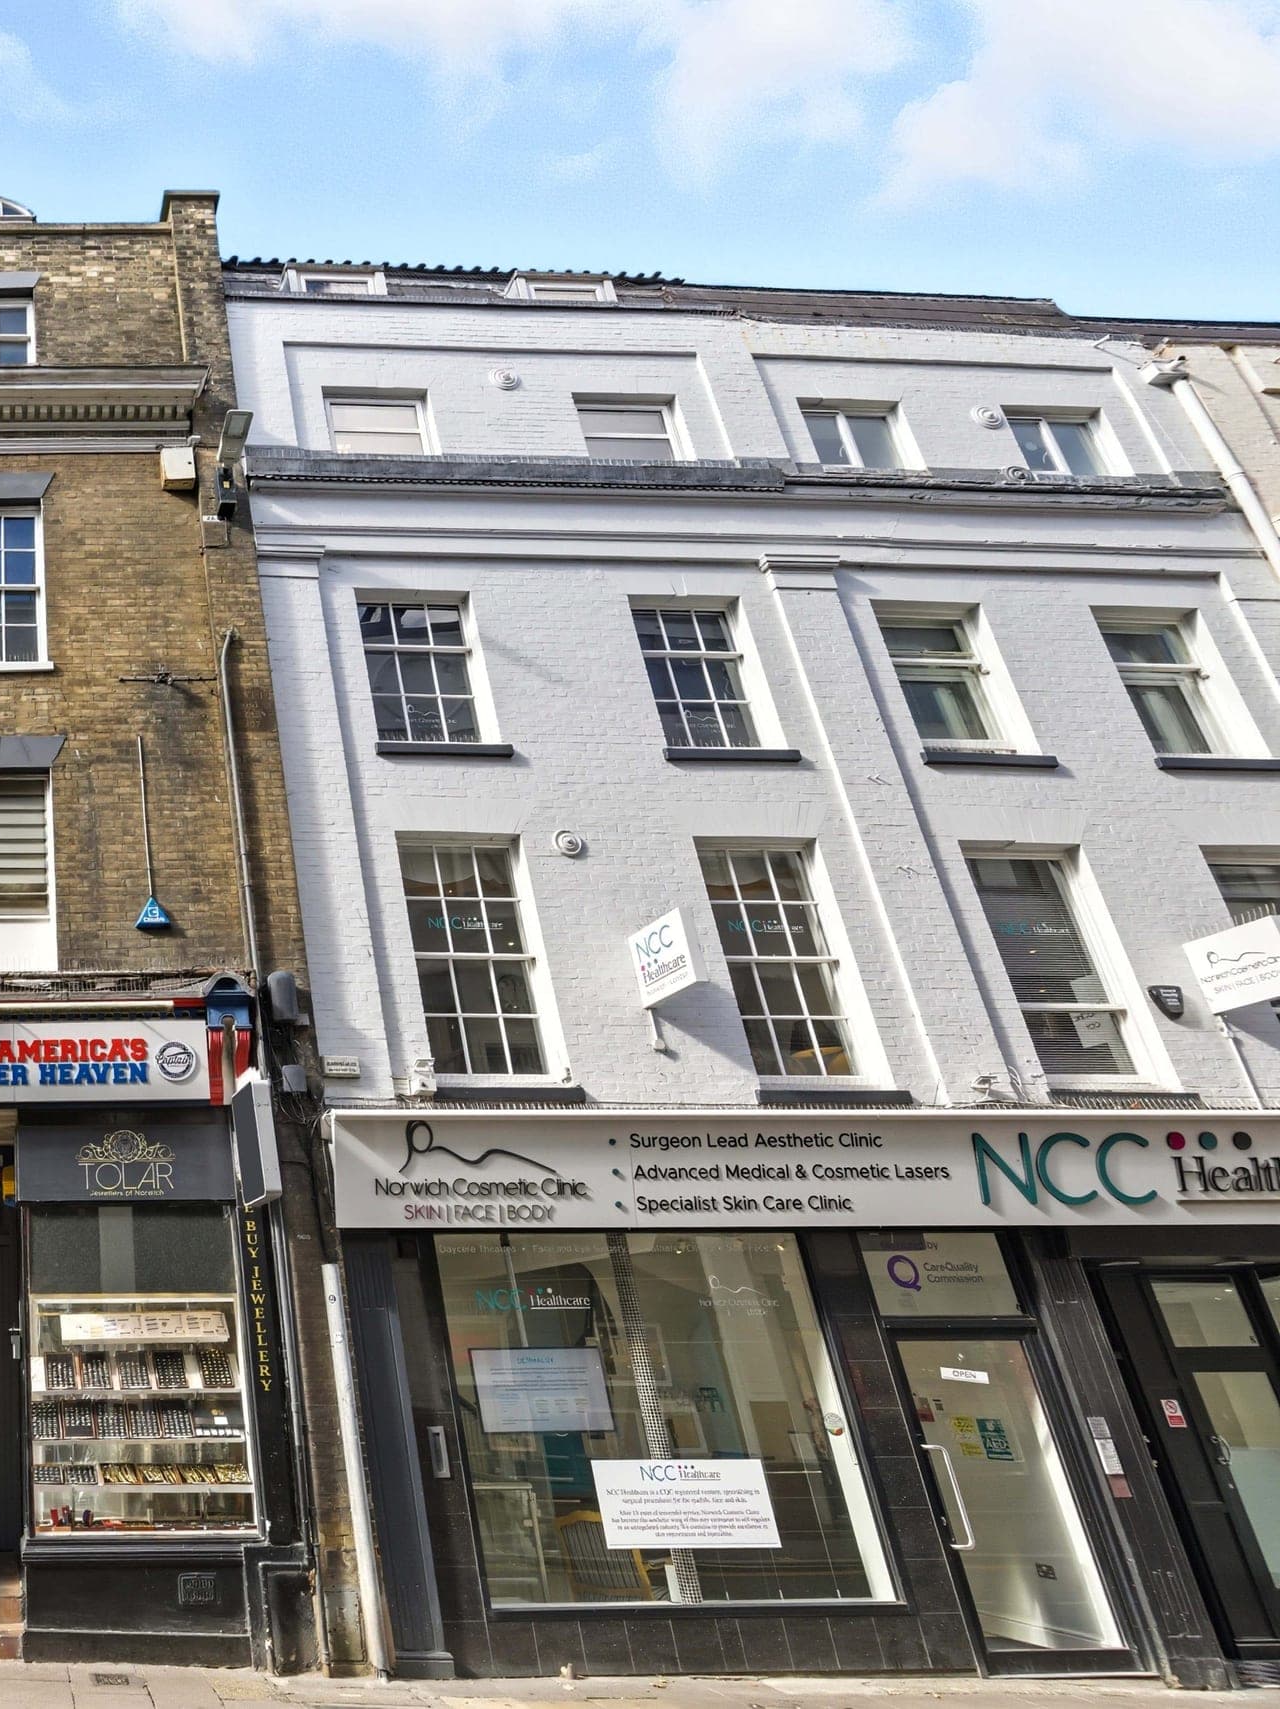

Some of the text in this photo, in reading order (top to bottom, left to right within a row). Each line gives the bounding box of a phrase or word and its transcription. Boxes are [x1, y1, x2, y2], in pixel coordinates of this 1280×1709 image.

[635, 924, 674, 962] NCC
[40, 1062, 149, 1086] HEAVEN
[630, 1132, 883, 1151] Surgeon Lead Aesthetic Clinic
[78, 1162, 174, 1190] TOLAR
[634, 1164, 950, 1180] Advanced Medical & Cosmetic Lasers
[971, 1132, 1280, 1206] NCC Healt
[375, 1178, 587, 1196] Norwich Cosmetic Clinic
[404, 1204, 554, 1221] SKIN FACE BODY
[637, 1195, 852, 1213] Specialist Skin Care Clinic
[245, 1220, 260, 1258] BUY
[927, 1274, 984, 1283] Commission
[530, 1295, 591, 1307] Healthcare
[250, 1266, 273, 1392] JEWELLERY
[952, 1370, 976, 1379] OPEN
[639, 1465, 721, 1482] NCC Healthcare
